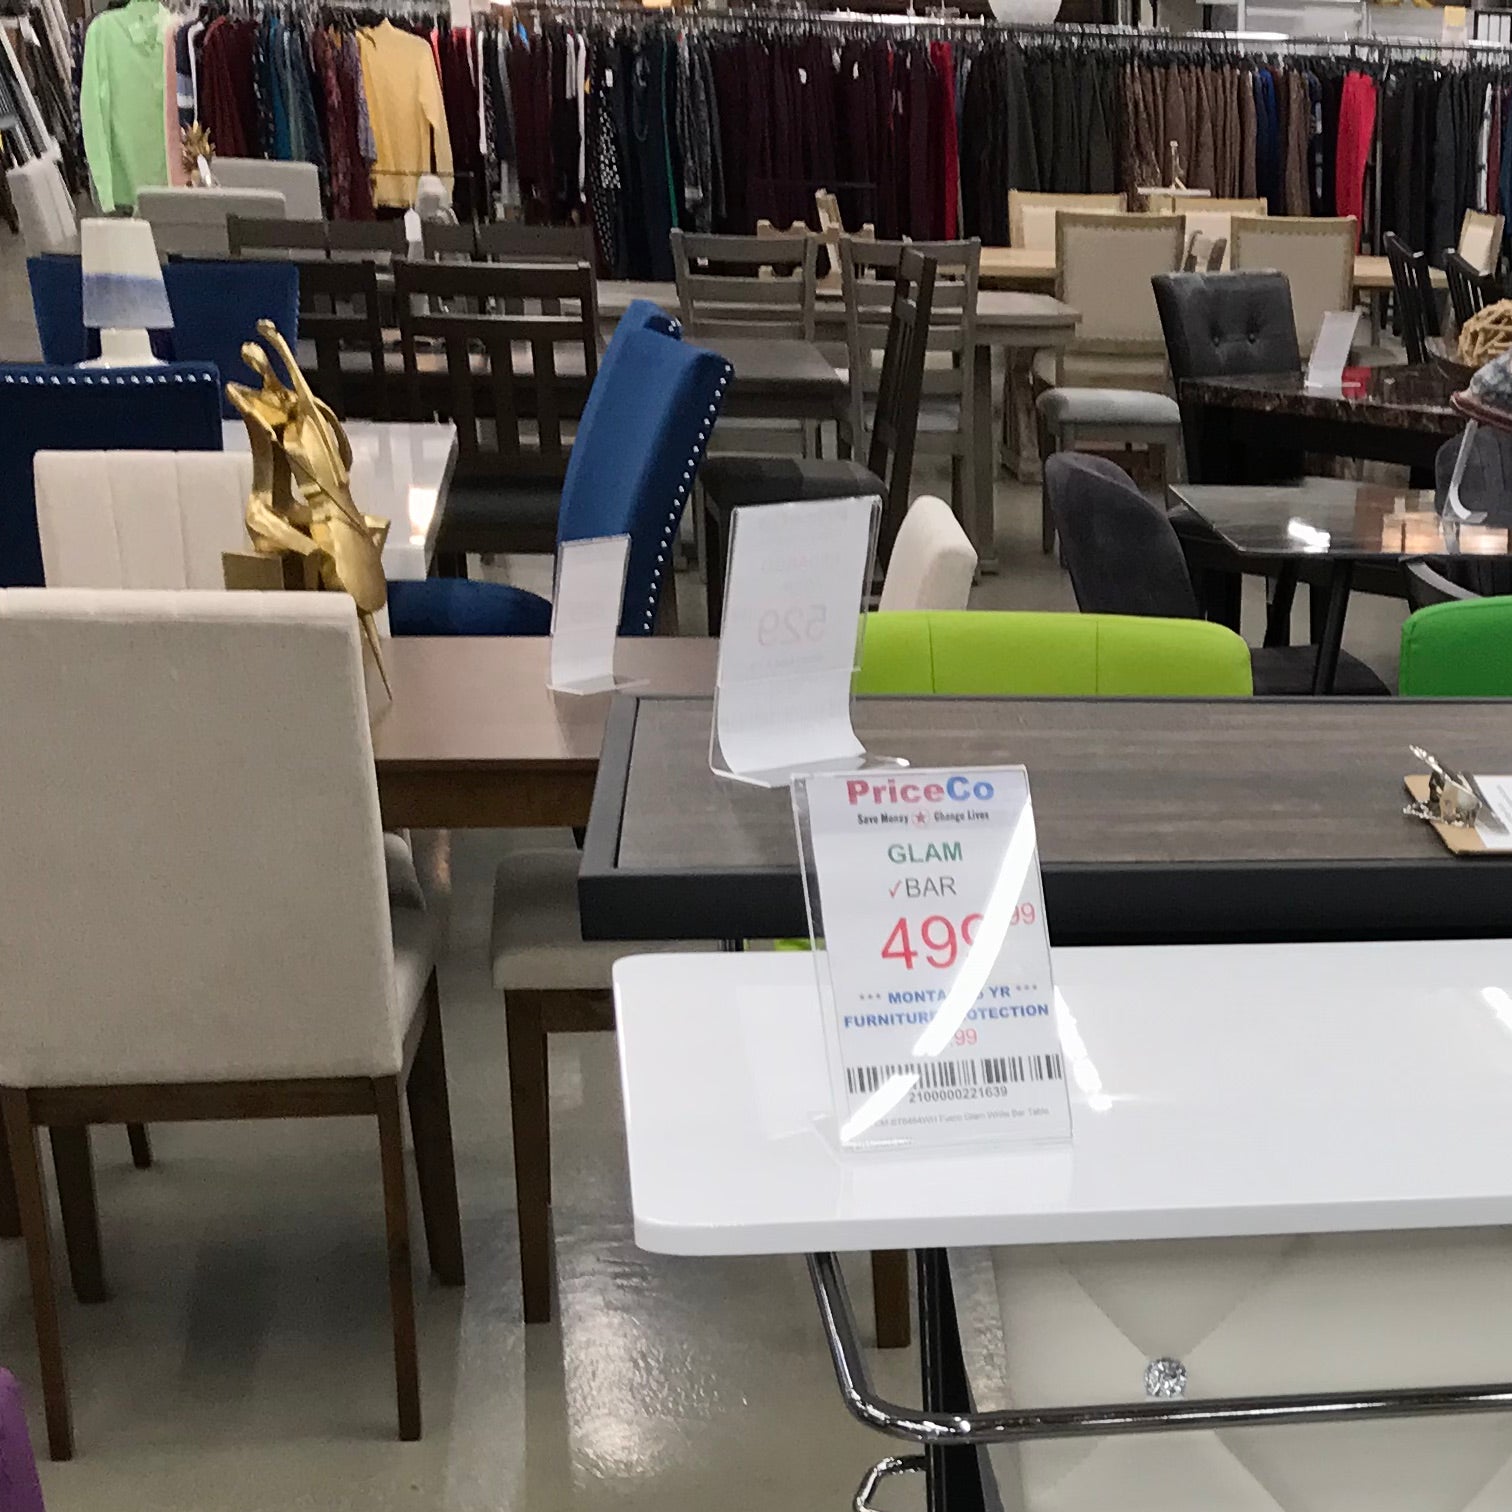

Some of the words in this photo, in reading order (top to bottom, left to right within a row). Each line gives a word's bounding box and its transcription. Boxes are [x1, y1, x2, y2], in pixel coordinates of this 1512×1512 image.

[846, 776, 995, 805] PriceCo
[857, 813, 879, 825] Save
[880, 811, 909, 825] Money
[934, 809, 965, 823] Change
[967, 808, 990, 821] Lives
[888, 841, 964, 865] GLAM
[905, 876, 958, 899] BAR
[889, 988, 947, 1004] MONTA
[988, 985, 1011, 999] YR
[966, 1003, 1049, 1021] OTECTION
[909, 1085, 1009, 1105] 2100000221639
